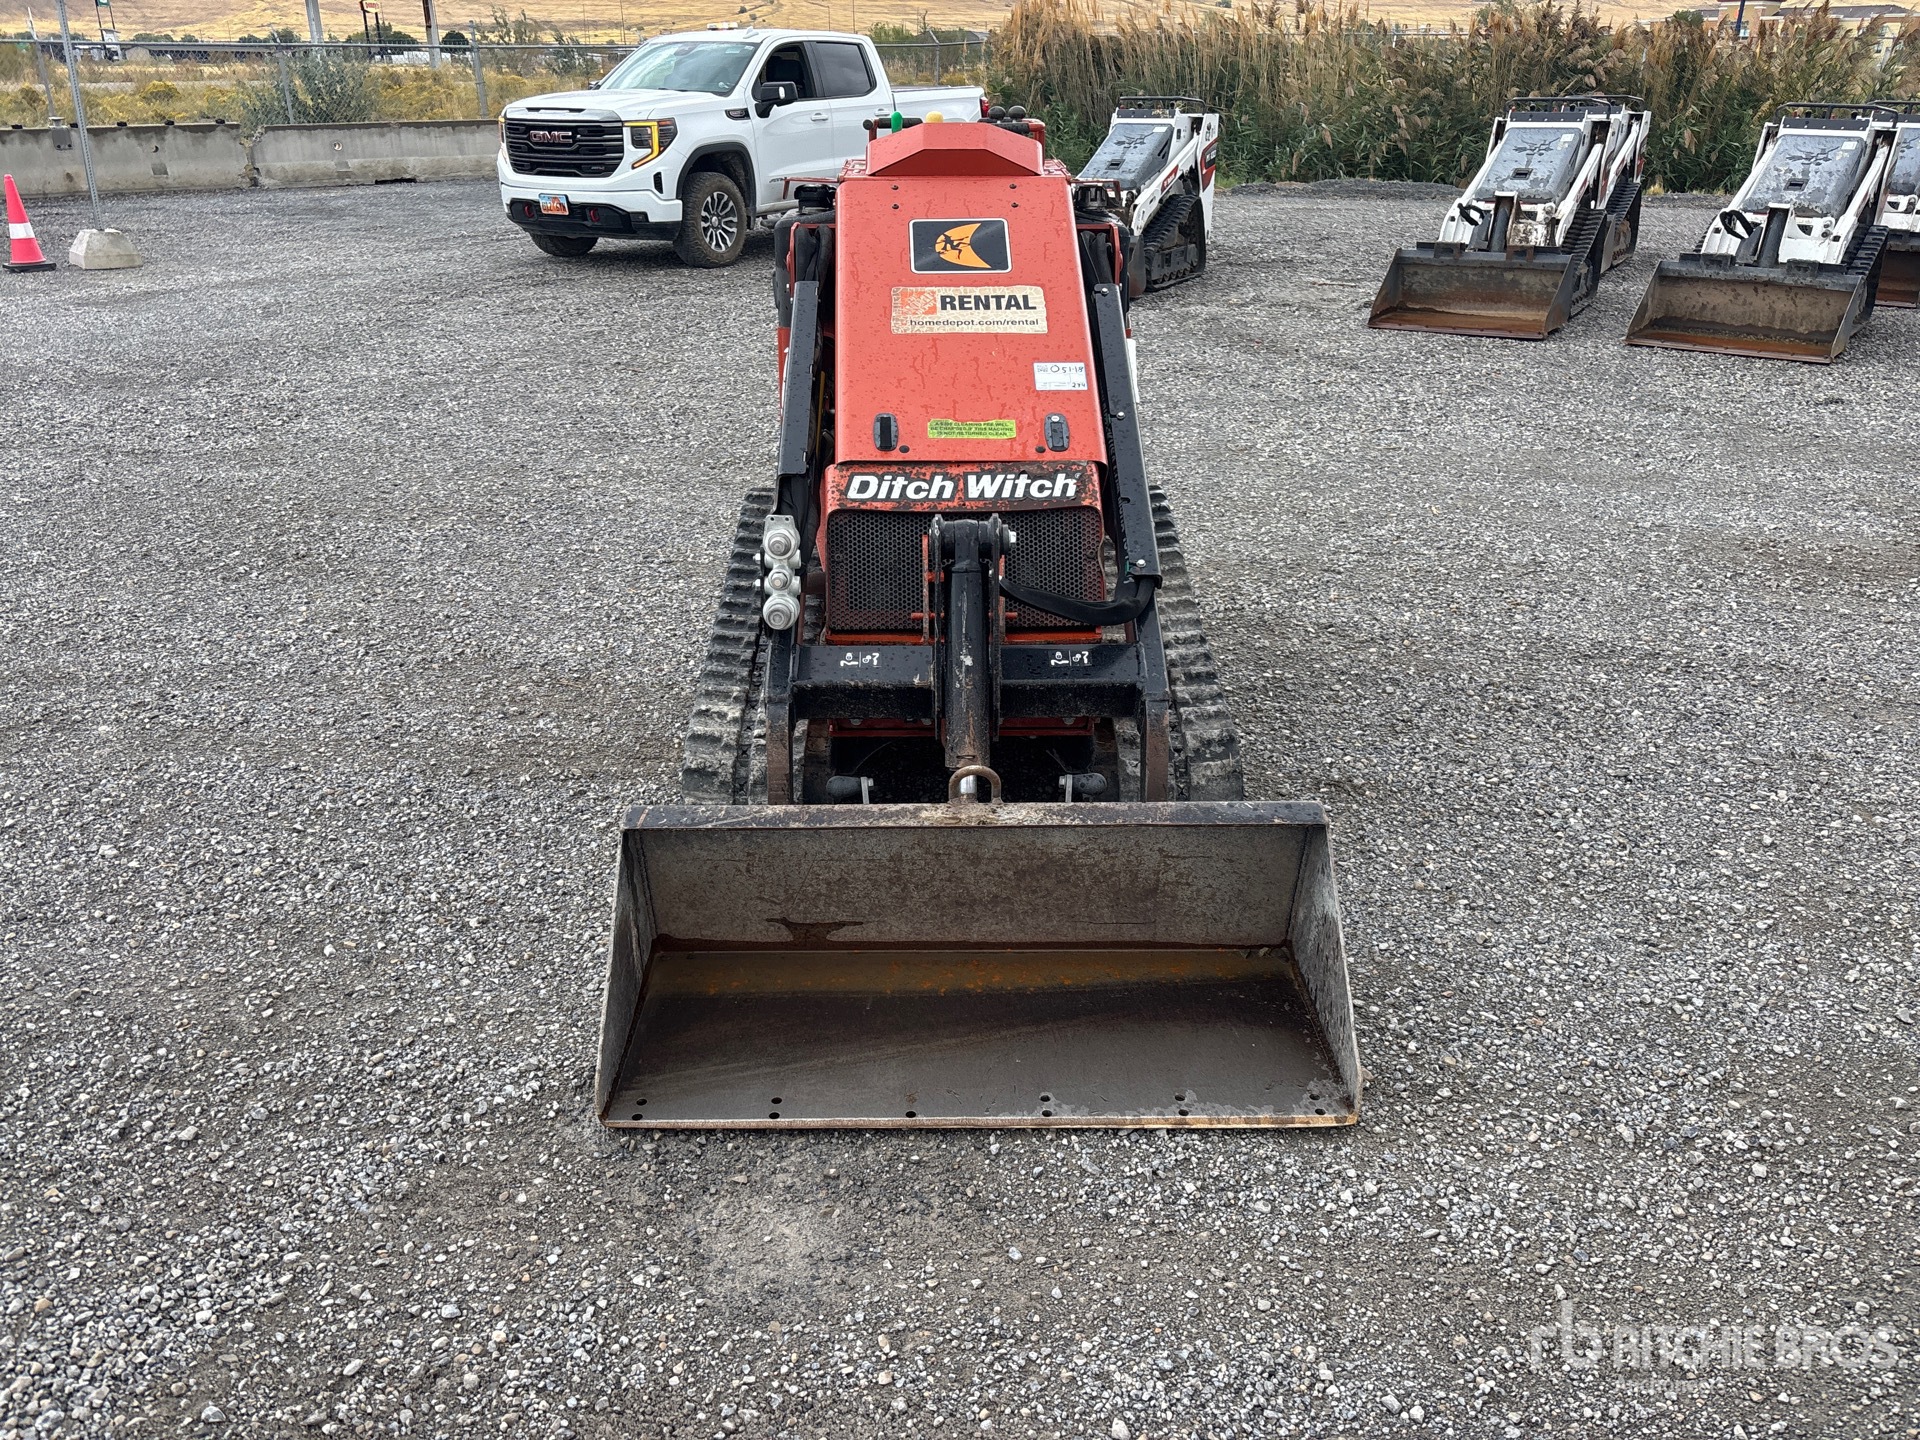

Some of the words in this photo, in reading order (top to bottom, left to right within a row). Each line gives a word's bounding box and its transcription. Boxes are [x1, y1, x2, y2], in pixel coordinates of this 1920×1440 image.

[529, 130, 573, 144] GMC
[940, 294, 1037, 311] RENTAL
[910, 318, 1039, 328] homedepot.com/rental
[847, 475, 954, 500] Ditch
[967, 473, 1077, 499] Witch
